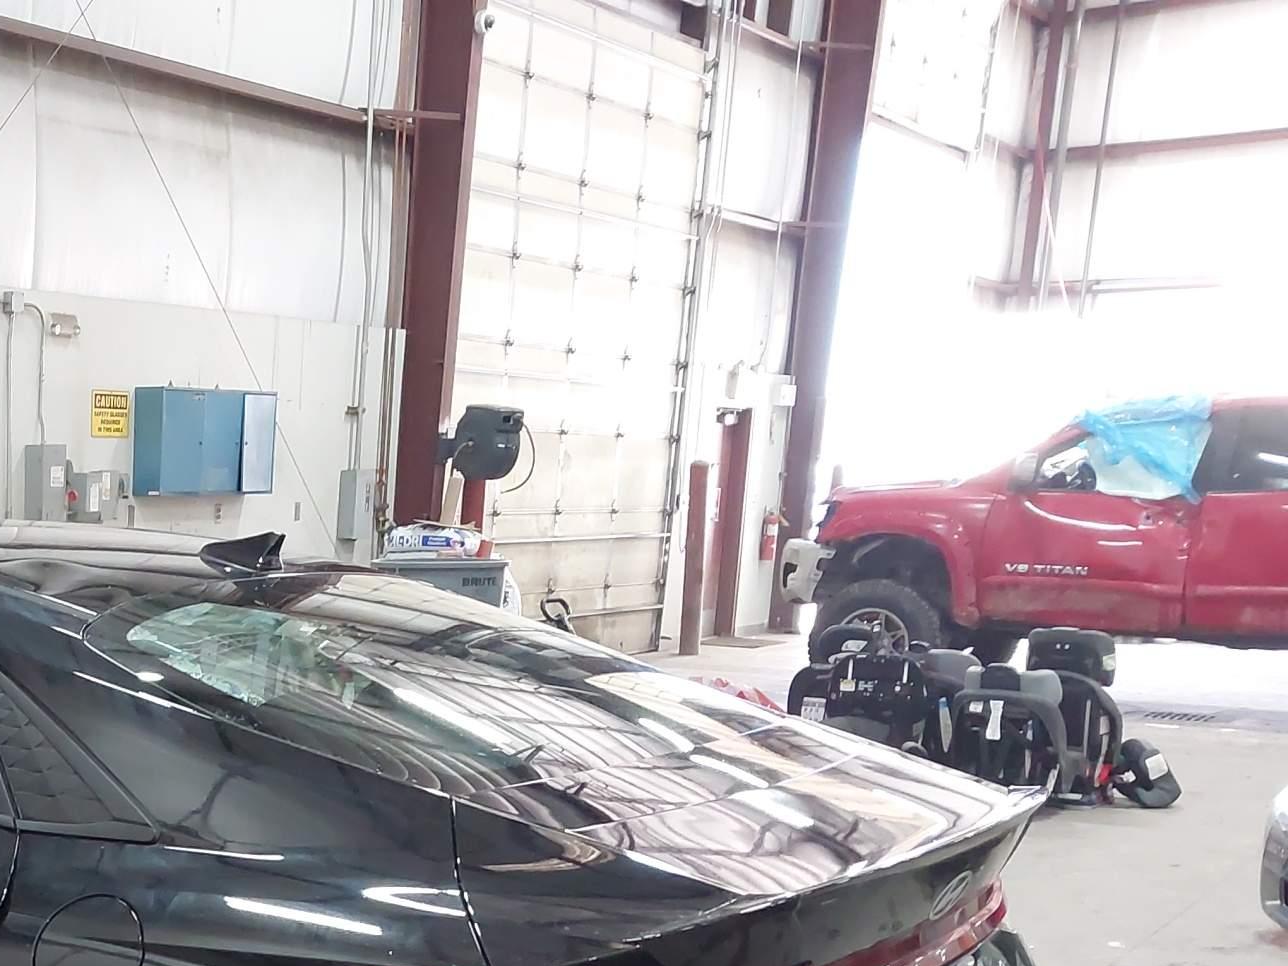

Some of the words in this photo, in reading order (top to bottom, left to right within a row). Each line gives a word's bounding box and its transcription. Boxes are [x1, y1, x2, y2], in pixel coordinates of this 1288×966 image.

[96, 395, 127, 408] CAUTION
[1004, 563, 1029, 573] V8
[1033, 564, 1088, 576] TITAN
[462, 576, 496, 587] BRUTE
